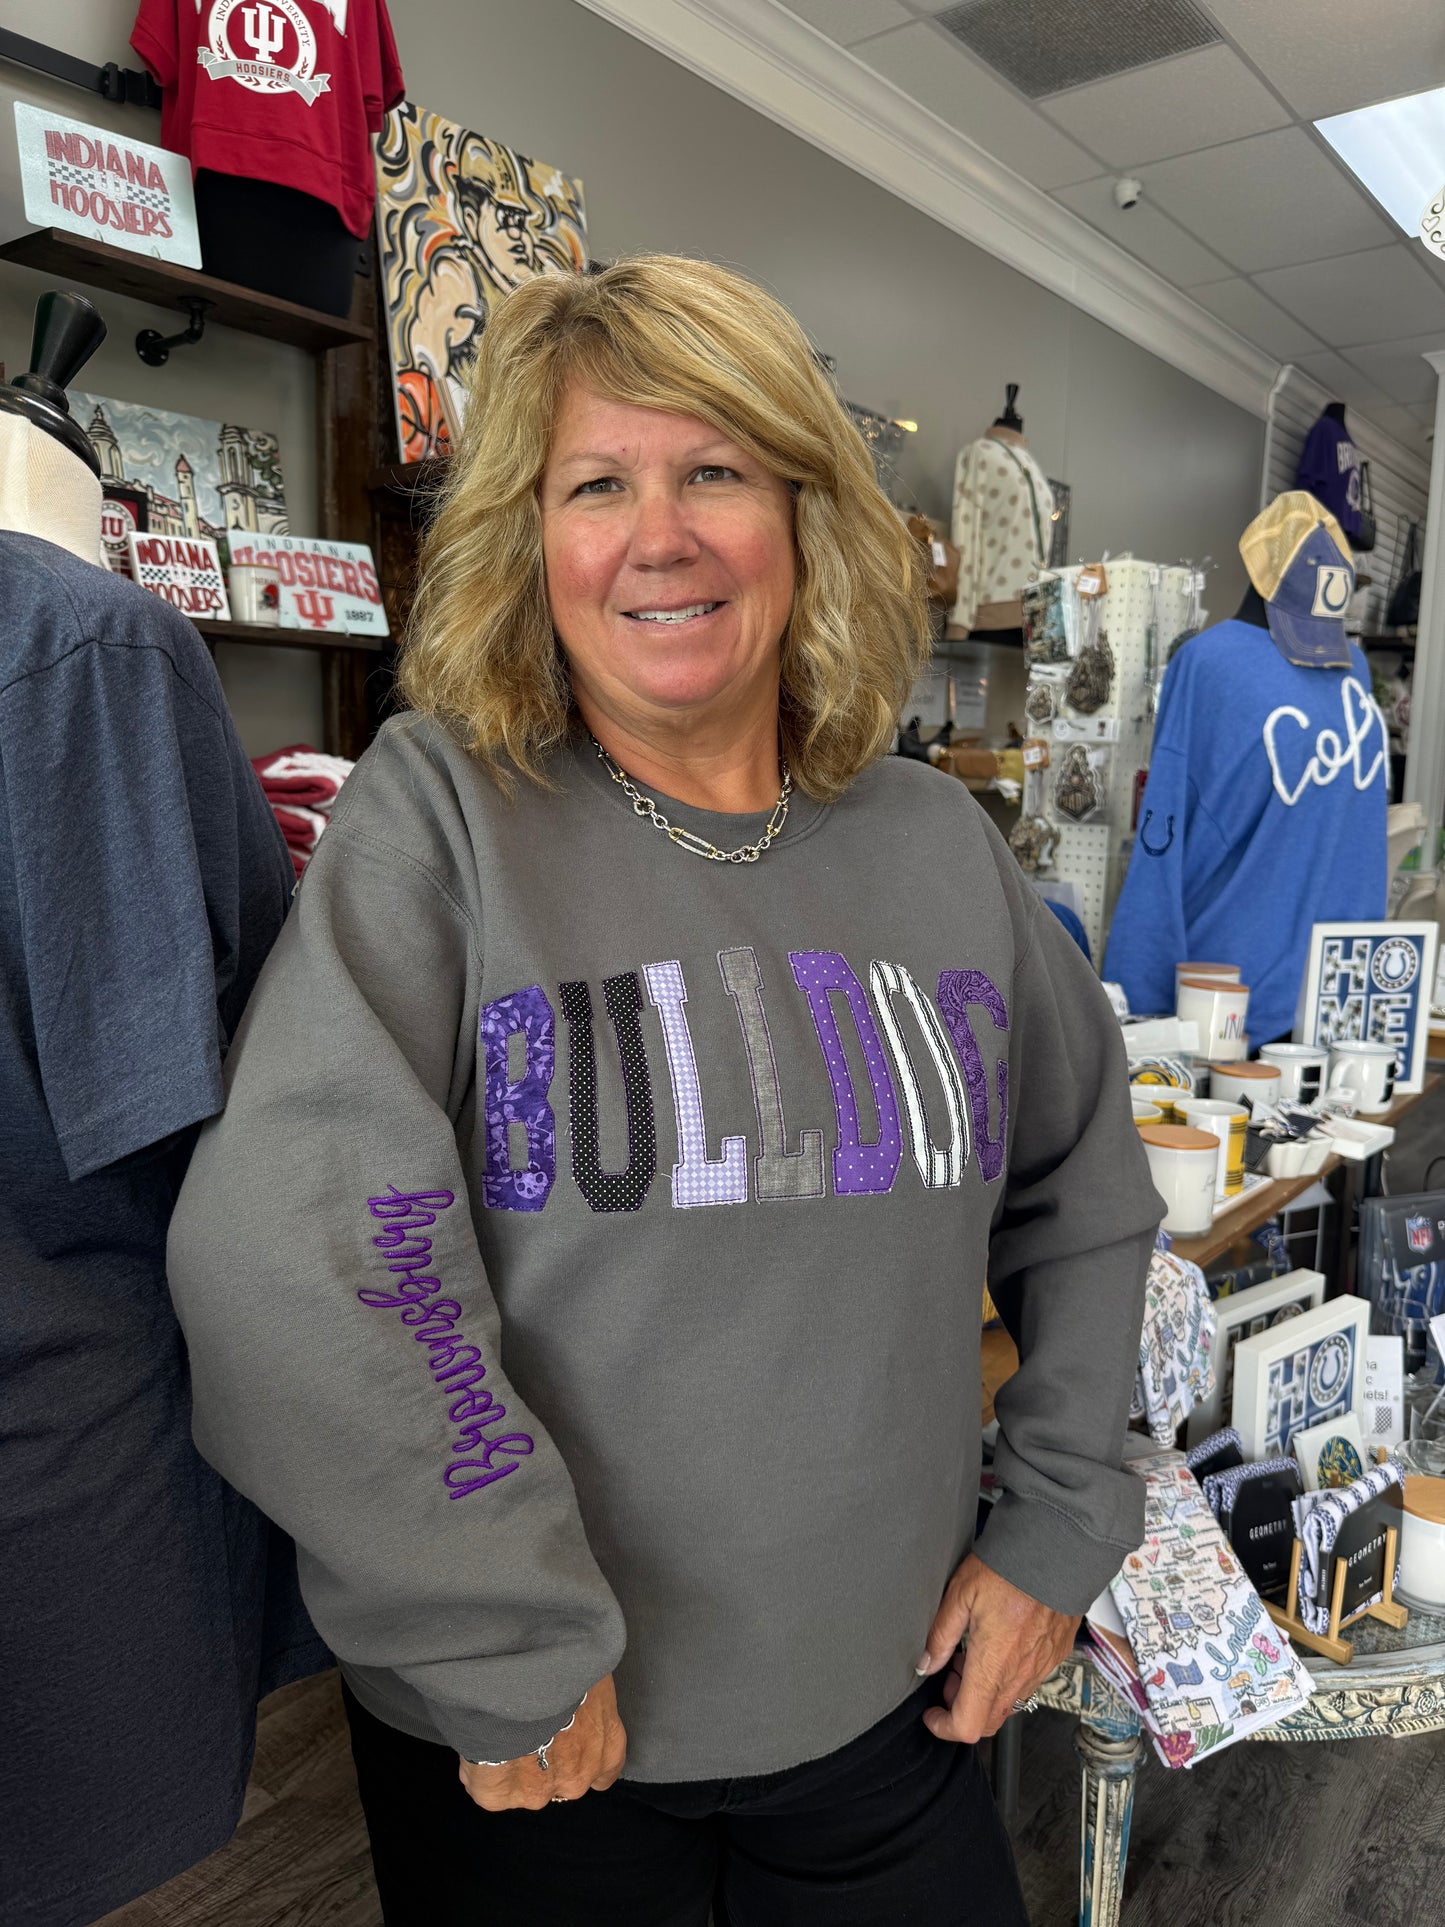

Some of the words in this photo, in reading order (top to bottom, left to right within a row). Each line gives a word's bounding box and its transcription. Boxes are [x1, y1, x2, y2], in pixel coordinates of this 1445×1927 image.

[236, 62, 291, 83] HOOSIERS
[44, 130, 170, 195] INDIANA
[50, 179, 174, 239] HOOSIERS
[136, 538, 217, 572] INDIANA
[254, 538, 357, 563] INDIANA
[344, 609, 375, 623] 1887
[480, 945, 1010, 1212] BULLDOG
[1411, 1227, 1434, 1247] NFL
[358, 1184, 535, 1500] Brownsburg
[1249, 1519, 1287, 1541] GEOMETRY
[1348, 1532, 1387, 1567] GEOMETRY
